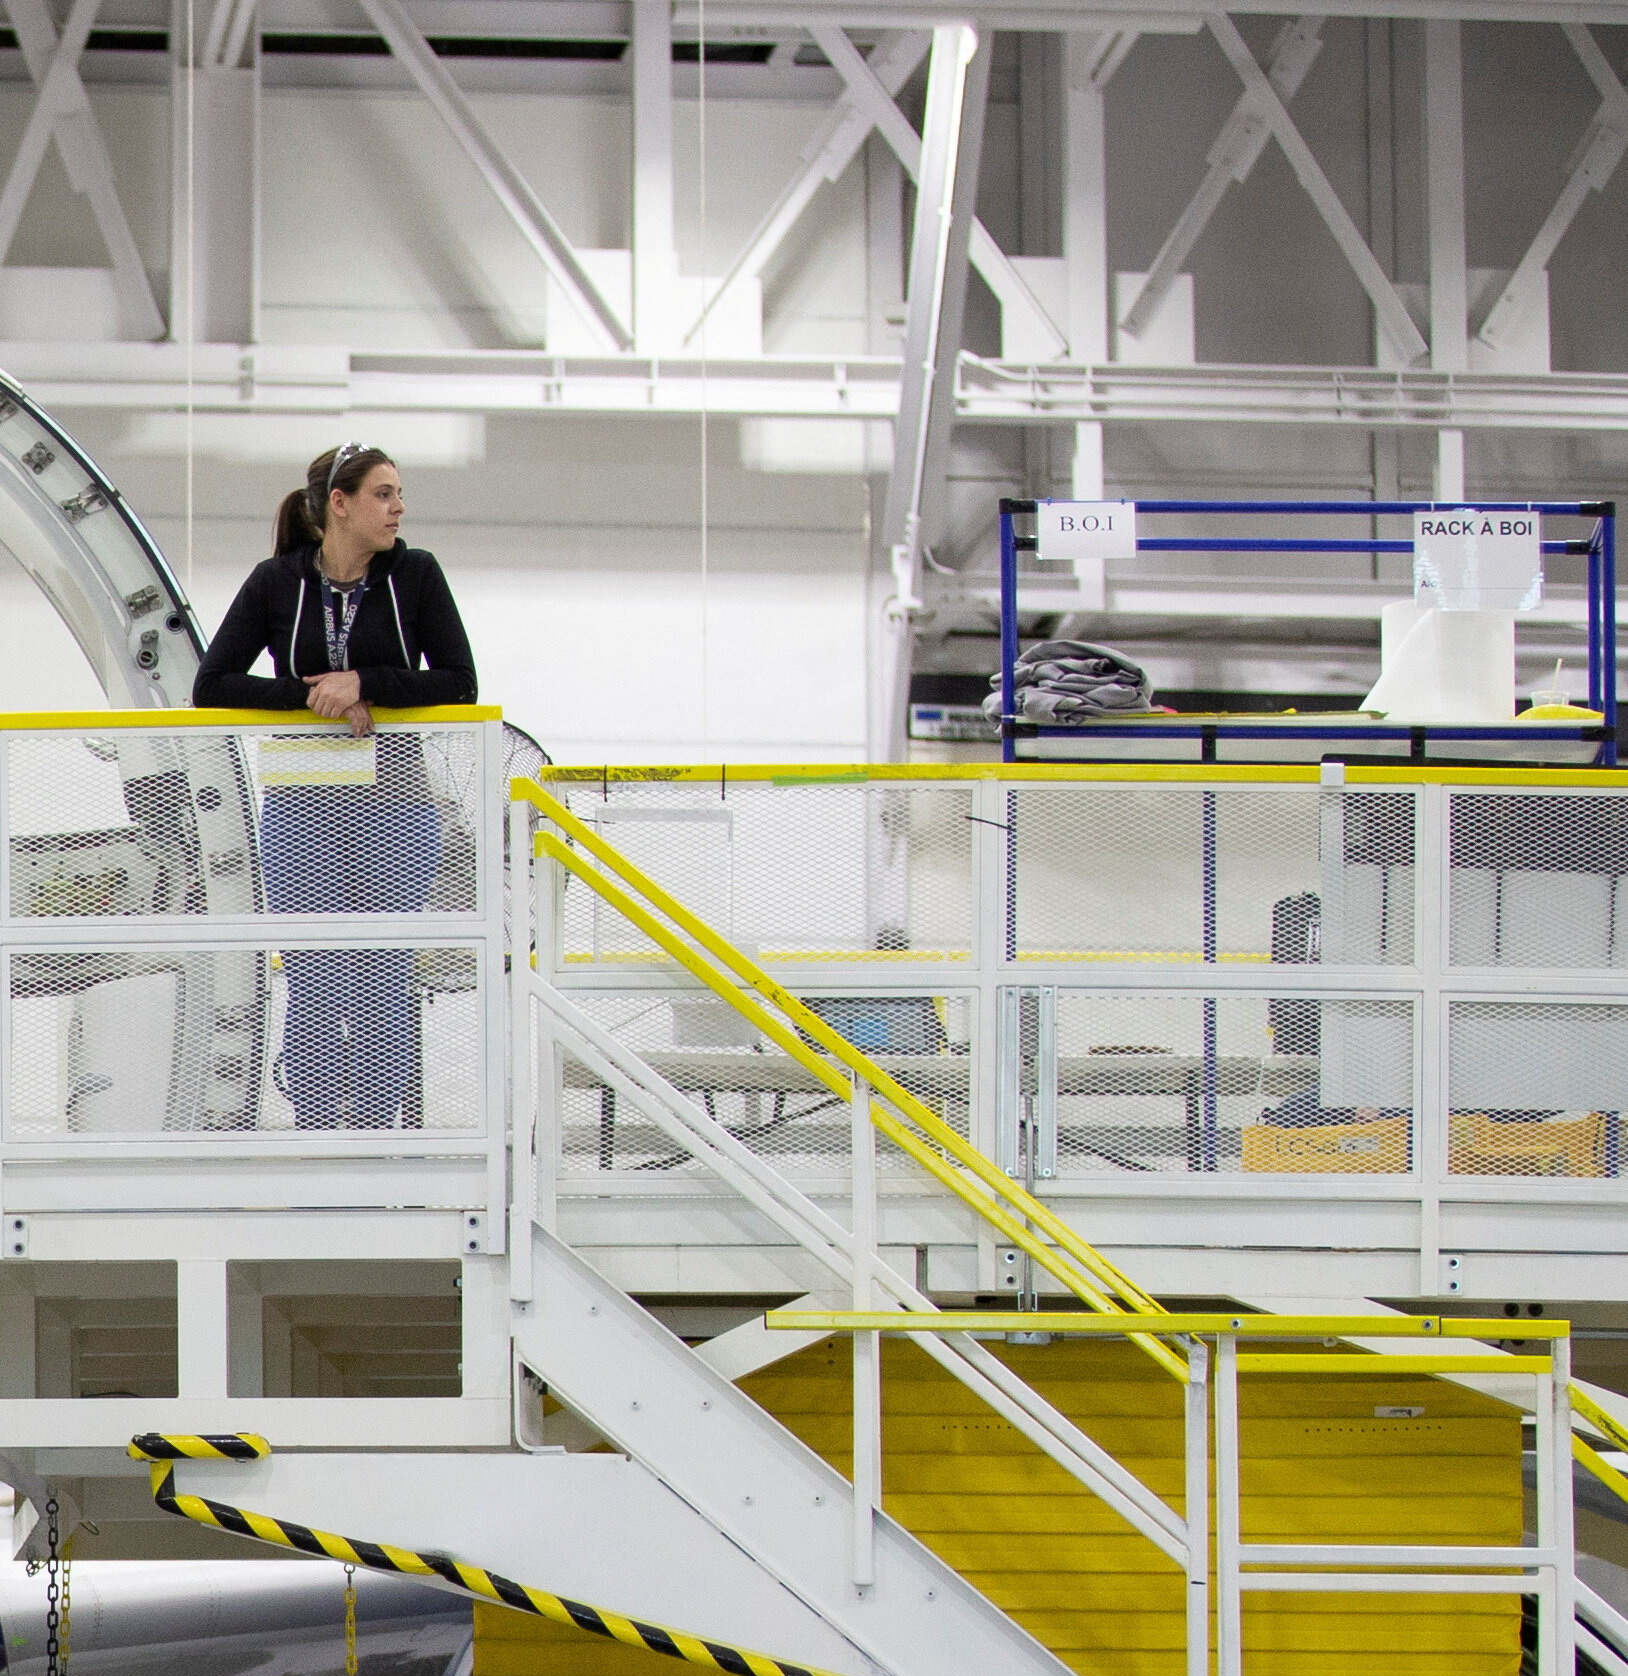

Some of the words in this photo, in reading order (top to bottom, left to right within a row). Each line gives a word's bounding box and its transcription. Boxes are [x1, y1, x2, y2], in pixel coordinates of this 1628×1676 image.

[1059, 515, 1115, 533] B.O.I
[1421, 521, 1475, 535] RACK
[1500, 521, 1532, 535] BOI
[341, 604, 358, 633] A220
[327, 643, 338, 669] A22
